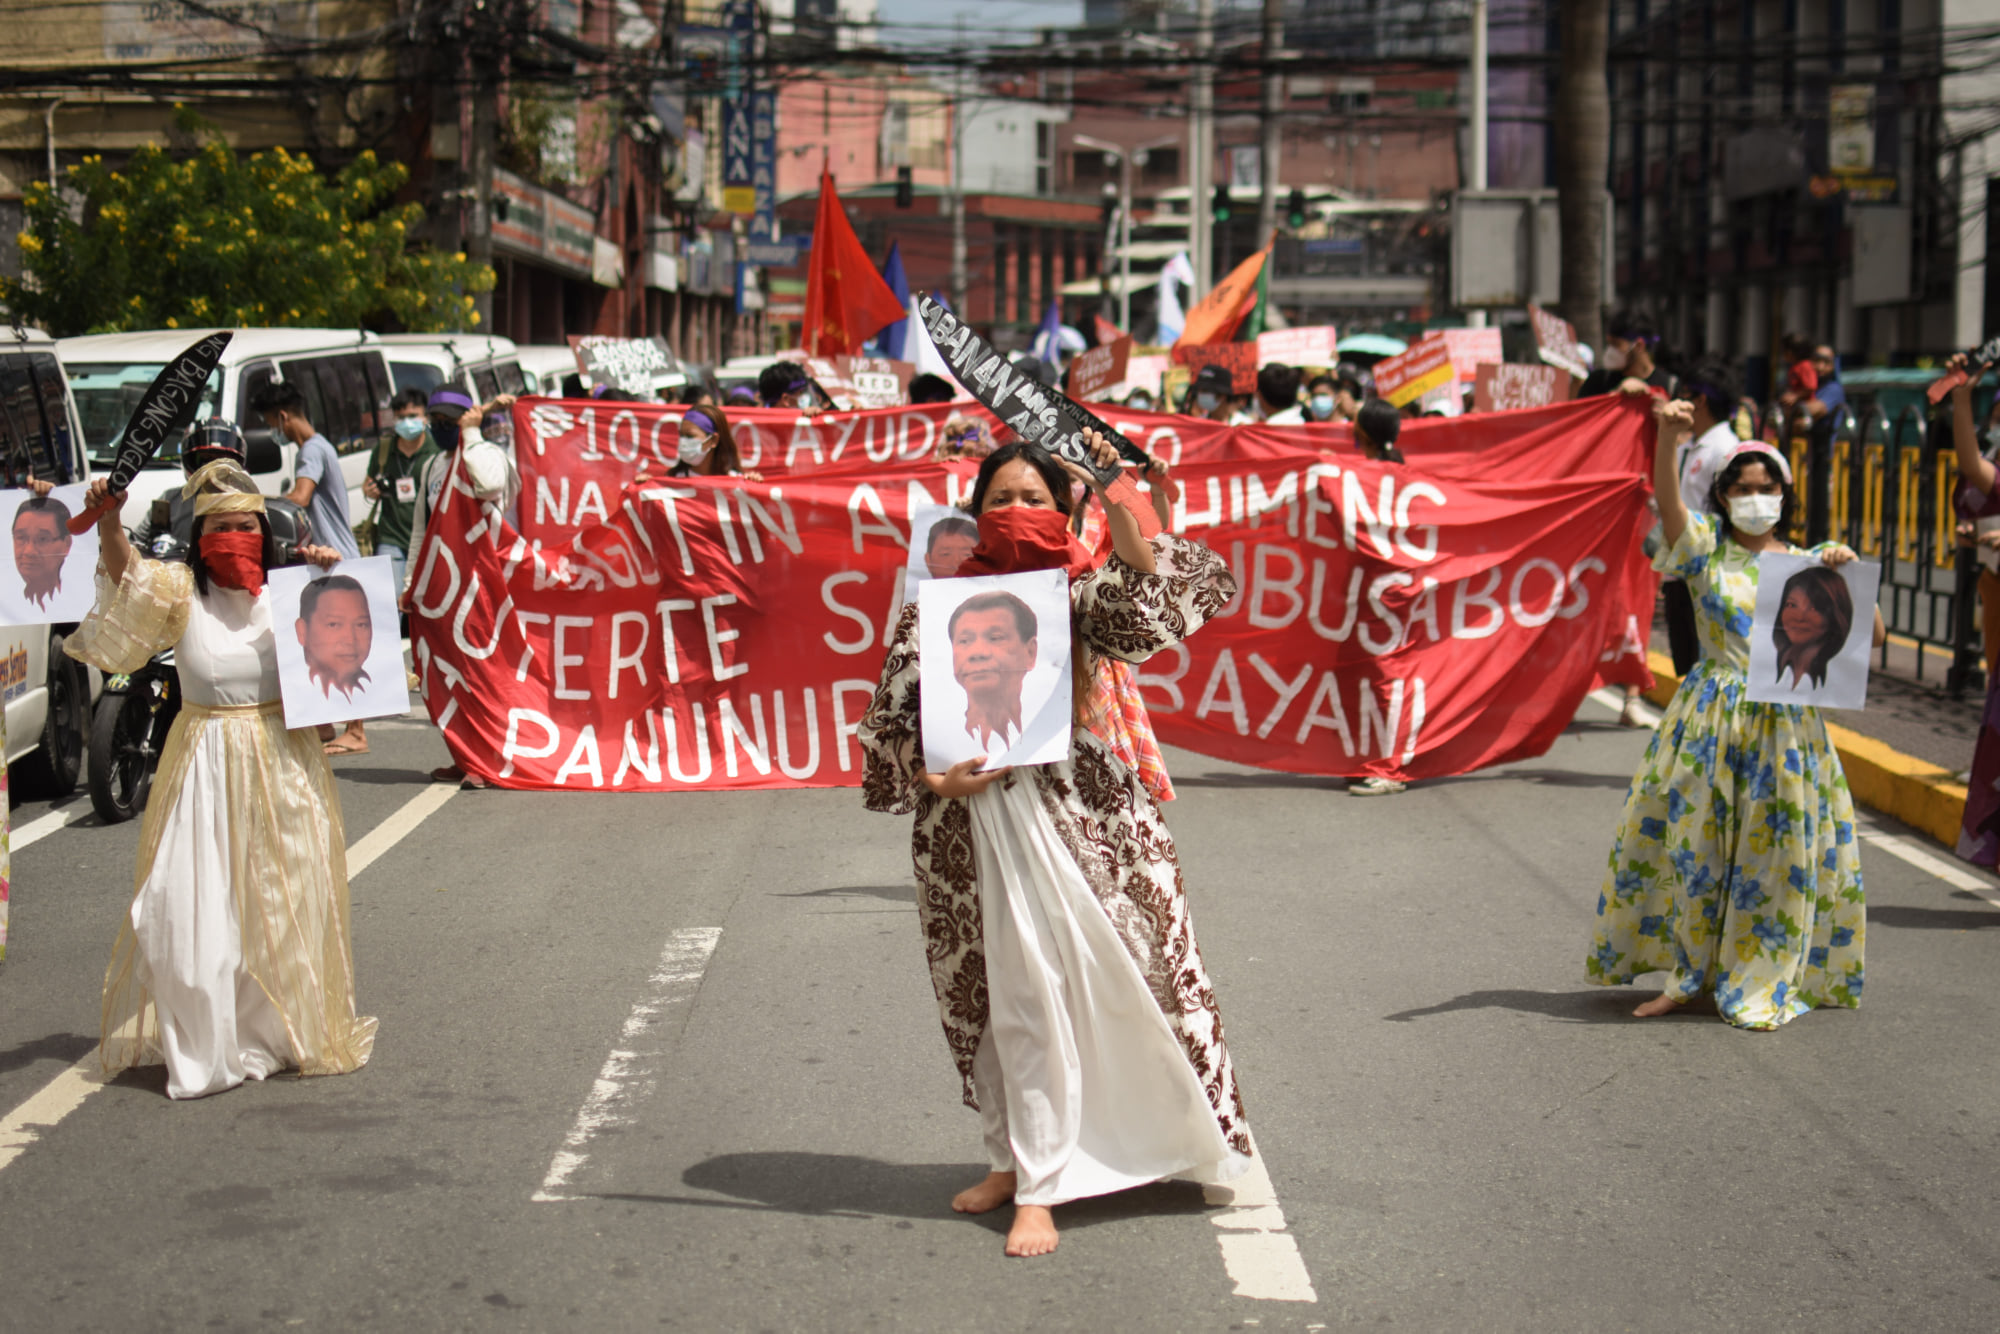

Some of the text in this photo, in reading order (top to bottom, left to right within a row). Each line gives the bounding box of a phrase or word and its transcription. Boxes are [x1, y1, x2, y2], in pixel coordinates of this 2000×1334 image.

[112, 337, 226, 486] NG BAGONG SIGLO
[1014, 382, 1059, 428] ANG
[412, 533, 749, 700] DUTERTE
[1129, 640, 1426, 765] BAYAN!
